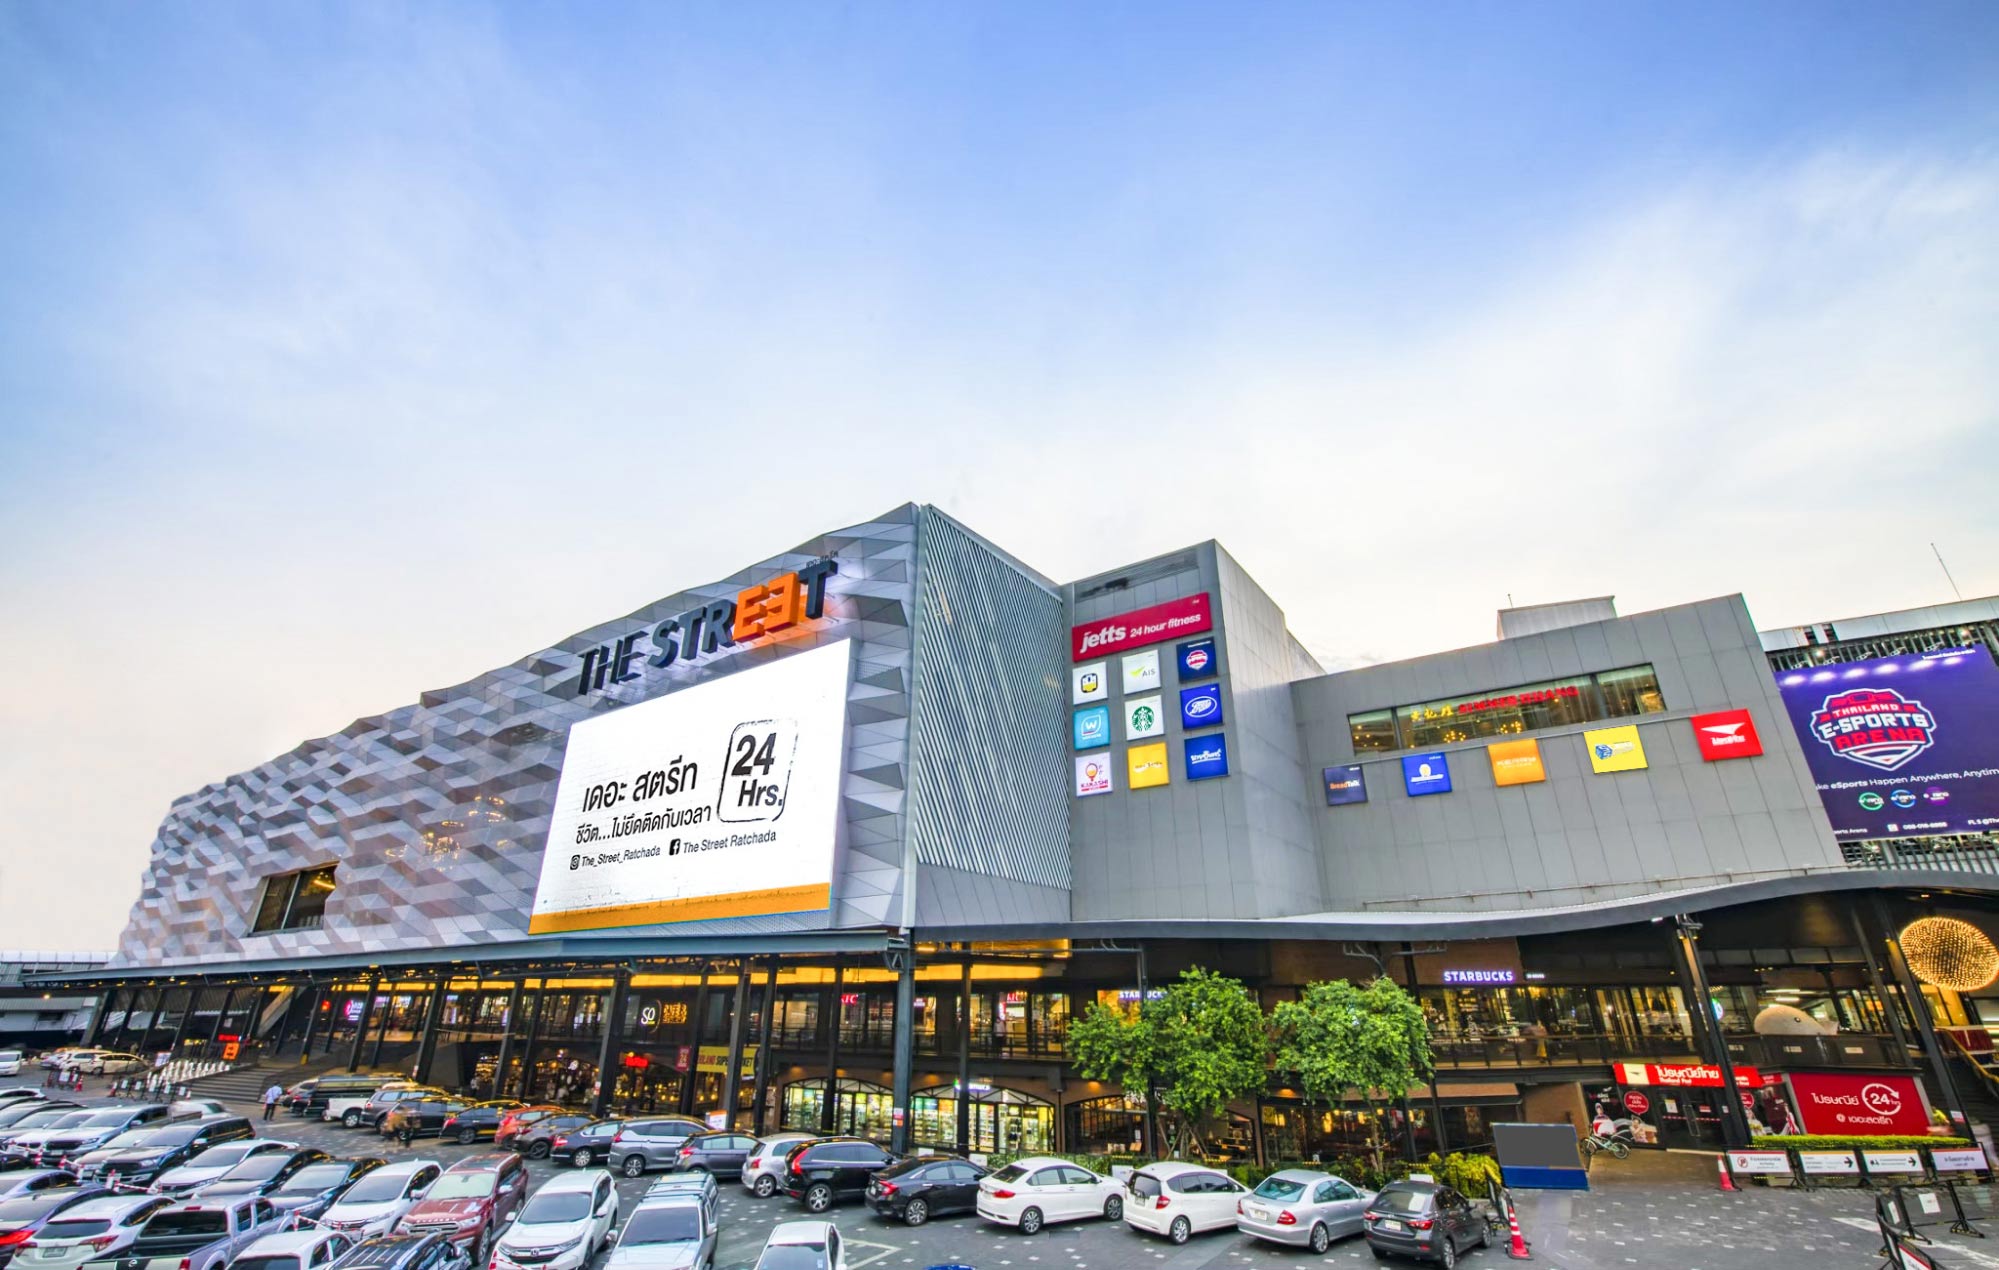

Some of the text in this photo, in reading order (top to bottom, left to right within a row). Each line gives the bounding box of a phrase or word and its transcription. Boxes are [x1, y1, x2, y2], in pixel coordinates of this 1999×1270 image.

[577, 560, 839, 695] THE STREET
[1079, 613, 1202, 654] jetts 24 hour fitness
[1142, 668, 1156, 678] AIS
[1832, 704, 1900, 717] THAILAND
[1818, 713, 1929, 739] E-SPORTS
[1834, 727, 1926, 750] ARENA
[731, 732, 777, 776] 24
[582, 754, 698, 813] เดอะ สตรีท
[1830, 780, 1868, 790] eSports
[1869, 777, 1908, 787] Happen
[1910, 771, 1963, 783] Anywhere,
[1963, 767, 1999, 778] Anytim
[737, 779, 783, 807] Hrs.
[683, 828, 777, 854] The Street Ratchada
[581, 845, 661, 867] The_Street_Ratchada
[1443, 970, 1514, 982] STARBUCKS
[1119, 989, 1168, 999] STARUCK
[1810, 1092, 1860, 1106] ไปรษณีย์
[1870, 1093, 1890, 1106] 24
